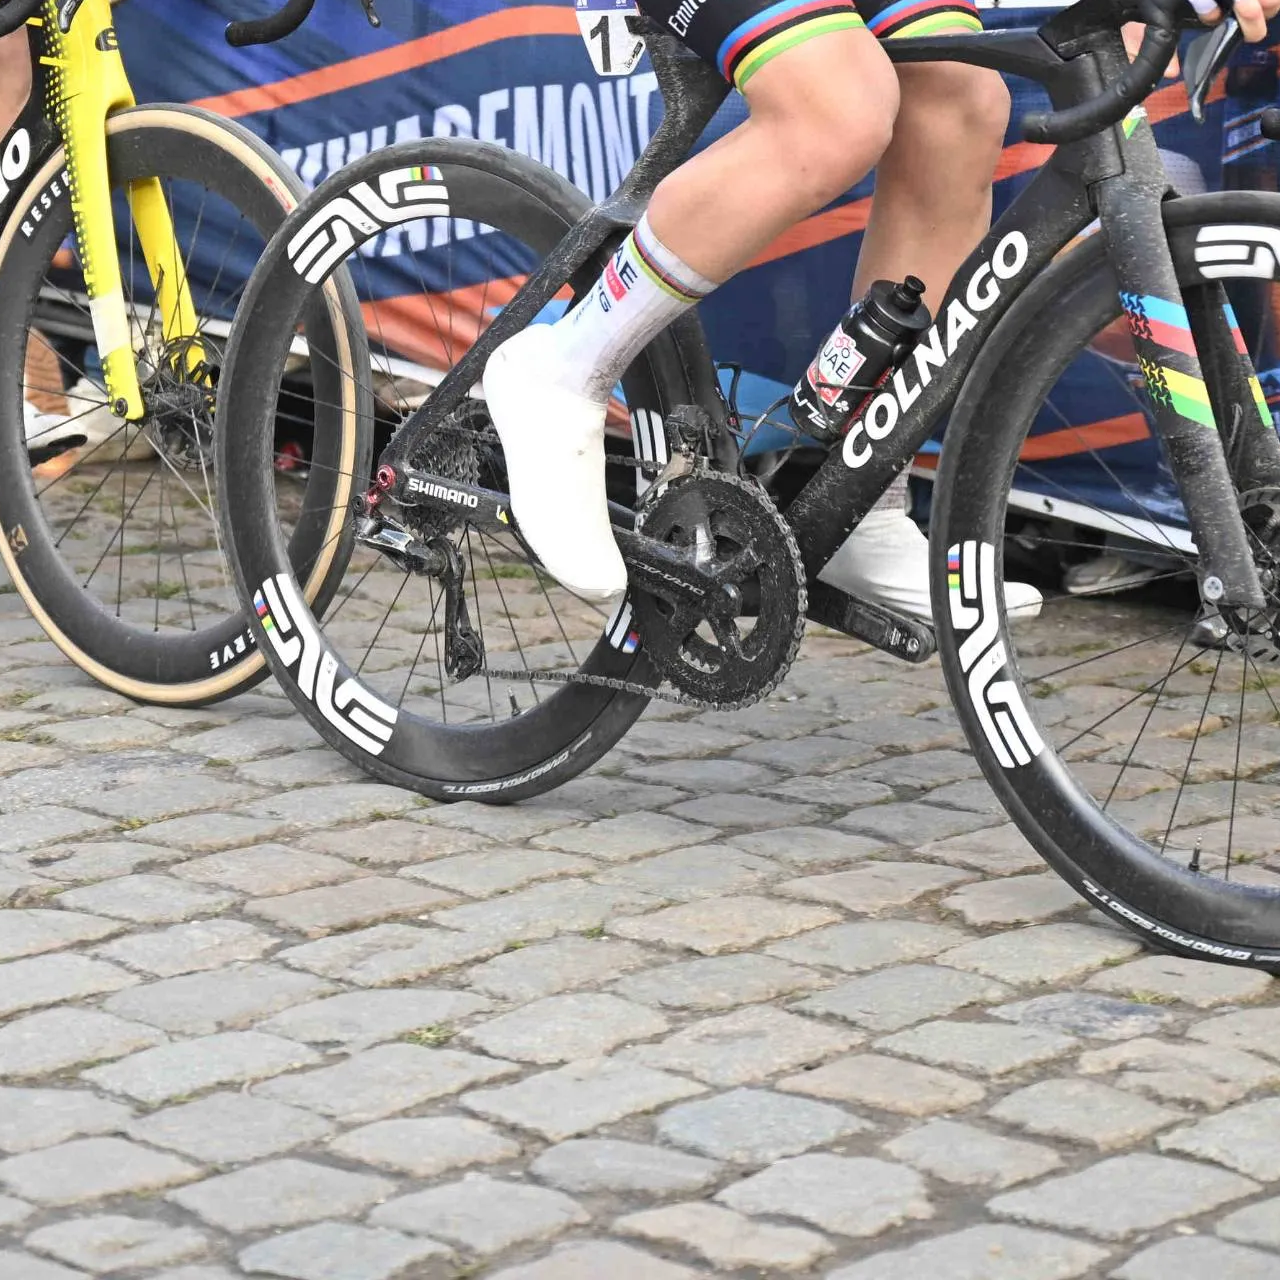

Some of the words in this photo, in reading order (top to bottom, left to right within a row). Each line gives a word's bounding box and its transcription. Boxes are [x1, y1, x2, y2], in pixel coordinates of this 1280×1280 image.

[590, 15, 612, 73] 1
[21, 170, 70, 238] RESE
[287, 166, 451, 285] ENVE
[841, 229, 1029, 470] COLNAGO
[408, 477, 478, 509] SHIMANO
[252, 574, 399, 756] ENVE
[947, 540, 1046, 769] ENVE
